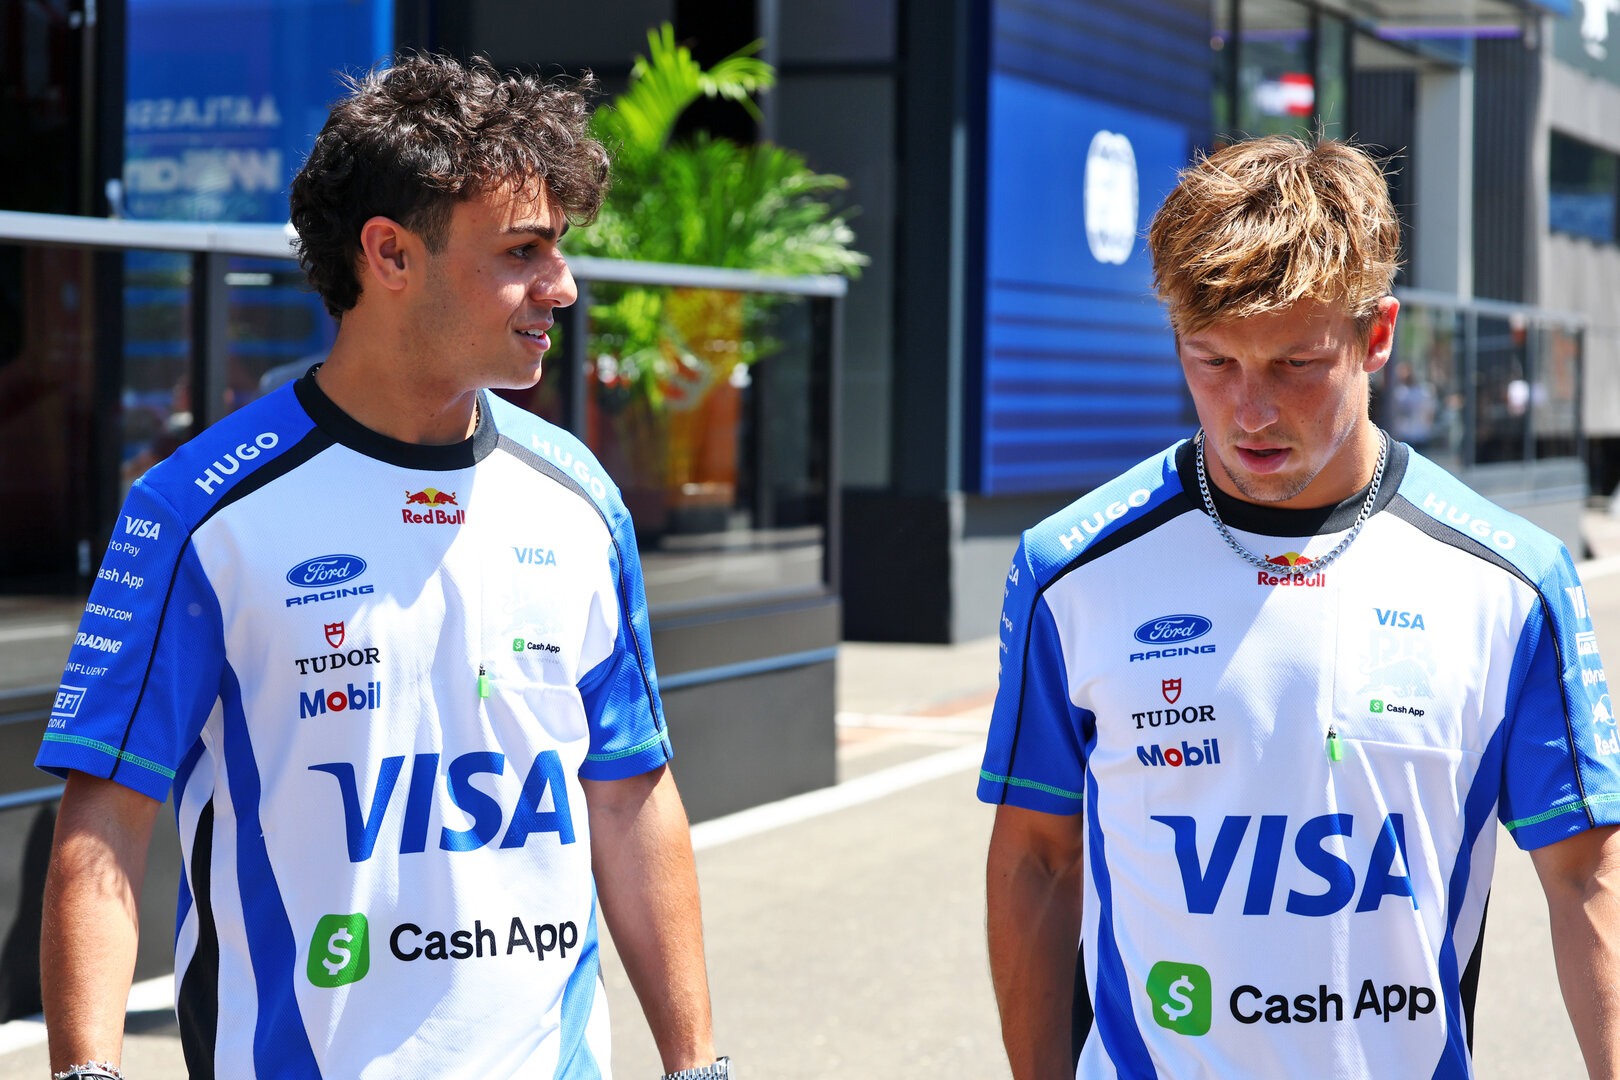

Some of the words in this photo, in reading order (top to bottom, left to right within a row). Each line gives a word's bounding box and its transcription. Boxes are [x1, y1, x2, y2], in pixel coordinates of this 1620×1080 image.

[194, 431, 279, 495] HUGO
[531, 433, 606, 500] HUGO
[125, 515, 161, 540] VISA
[401, 509, 434, 524] Red
[436, 510, 466, 525] Bull
[1058, 488, 1151, 551] HUGO
[1422, 492, 1517, 550] HUGO
[111, 540, 122, 551] to
[123, 543, 140, 557] Pay
[511, 546, 557, 566] VISA
[97, 567, 119, 582] ash
[121, 571, 144, 589] App
[303, 562, 351, 584] Ford
[1257, 571, 1290, 586] Red
[1293, 572, 1326, 588] Bull
[285, 585, 375, 608] RACING
[1149, 619, 1196, 641] Ford
[1372, 607, 1425, 631] VISA
[74, 632, 123, 654] TRADING
[527, 641, 545, 651] Cash
[545, 643, 561, 653] App
[1129, 644, 1216, 662] RACING
[295, 647, 381, 675] TUDOR
[299, 682, 381, 719] Mobil
[1386, 704, 1407, 713] Cash
[1408, 707, 1425, 717] App
[1132, 705, 1216, 729] TUDOR
[1136, 738, 1221, 767] Mobil
[308, 749, 576, 863] VISA
[1150, 812, 1419, 917] VISA
[389, 919, 497, 962] Cash
[506, 916, 578, 962] App
[1229, 984, 1343, 1024] Cash
[1353, 979, 1437, 1023] App
